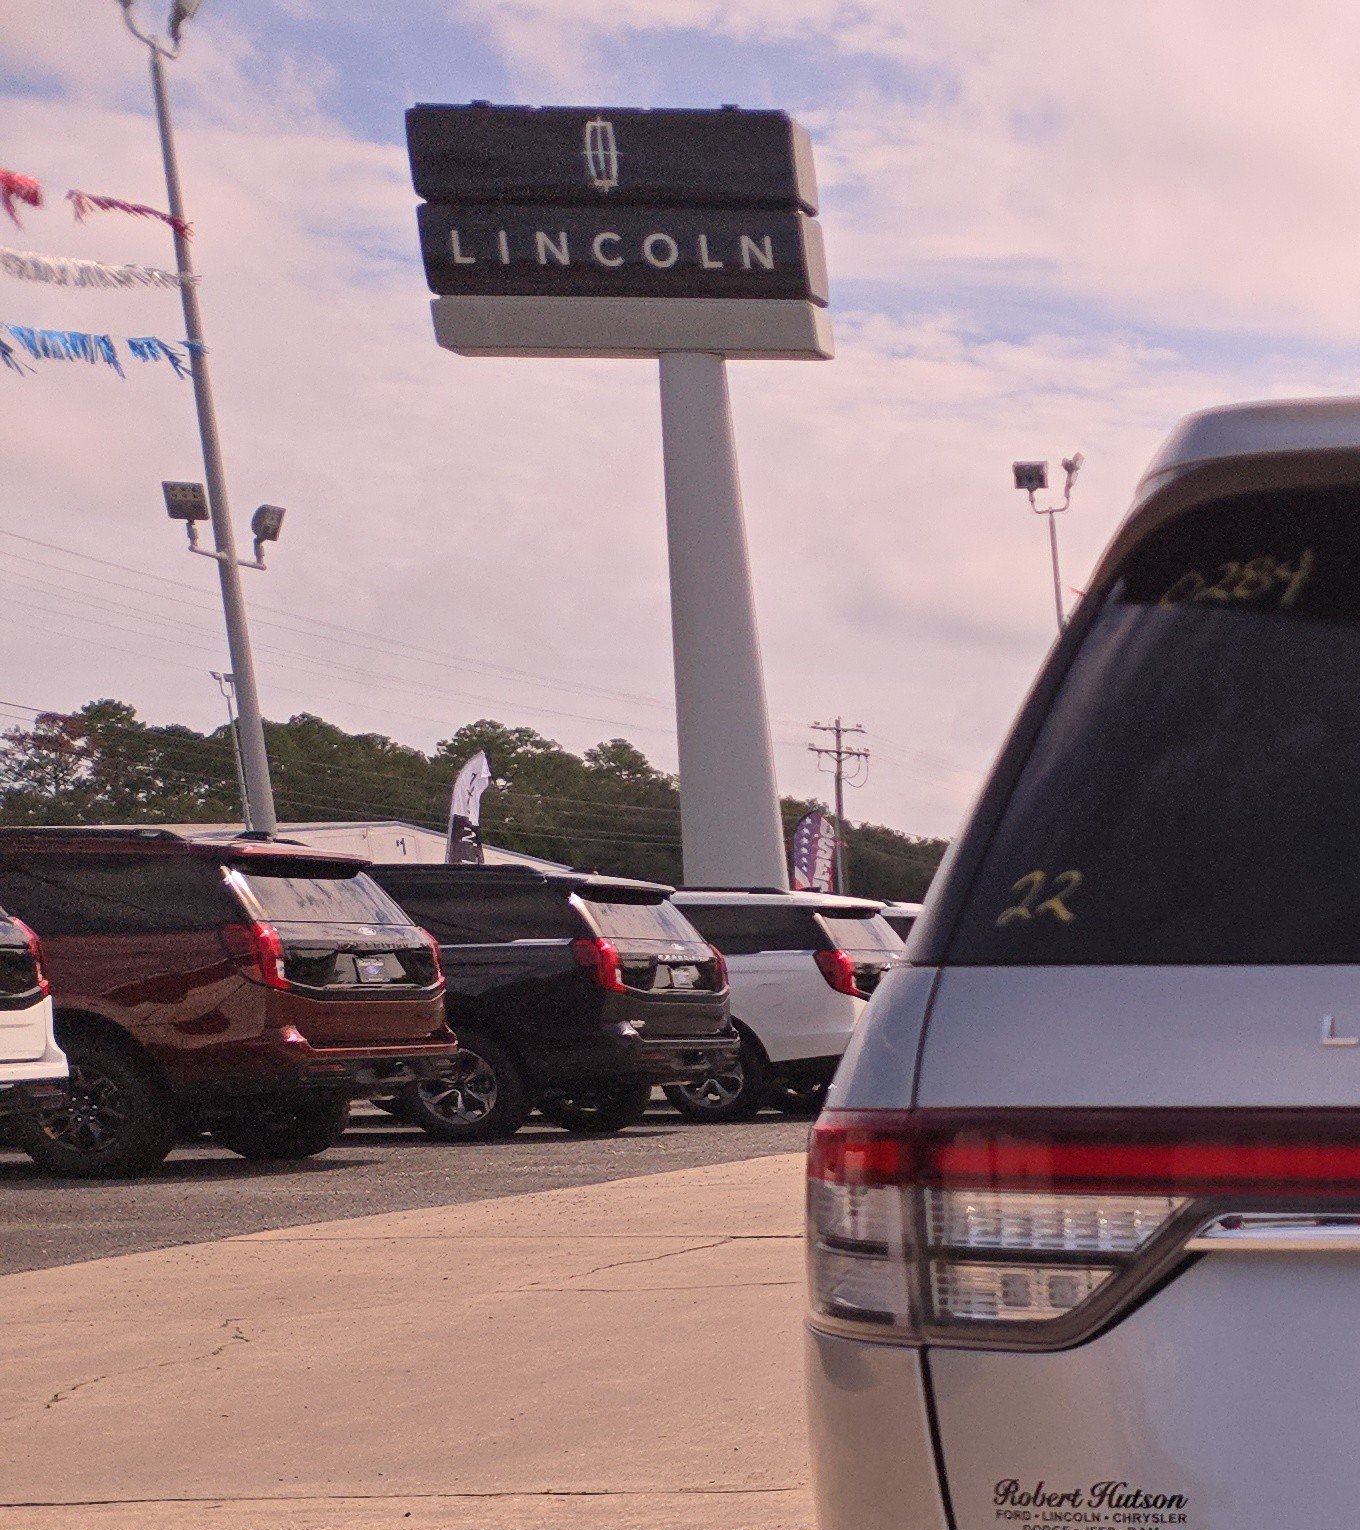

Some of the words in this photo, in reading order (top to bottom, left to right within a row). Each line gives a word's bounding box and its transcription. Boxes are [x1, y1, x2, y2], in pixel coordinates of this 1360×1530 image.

[450, 230, 774, 269] LINCOLN
[993, 1478, 1083, 1507] Robert
[1087, 1480, 1188, 1510] Hutson
[995, 1510, 1031, 1521] FORD
[1042, 1511, 1101, 1523] LINCOLN
[1112, 1512, 1187, 1524] CHRYSLER
